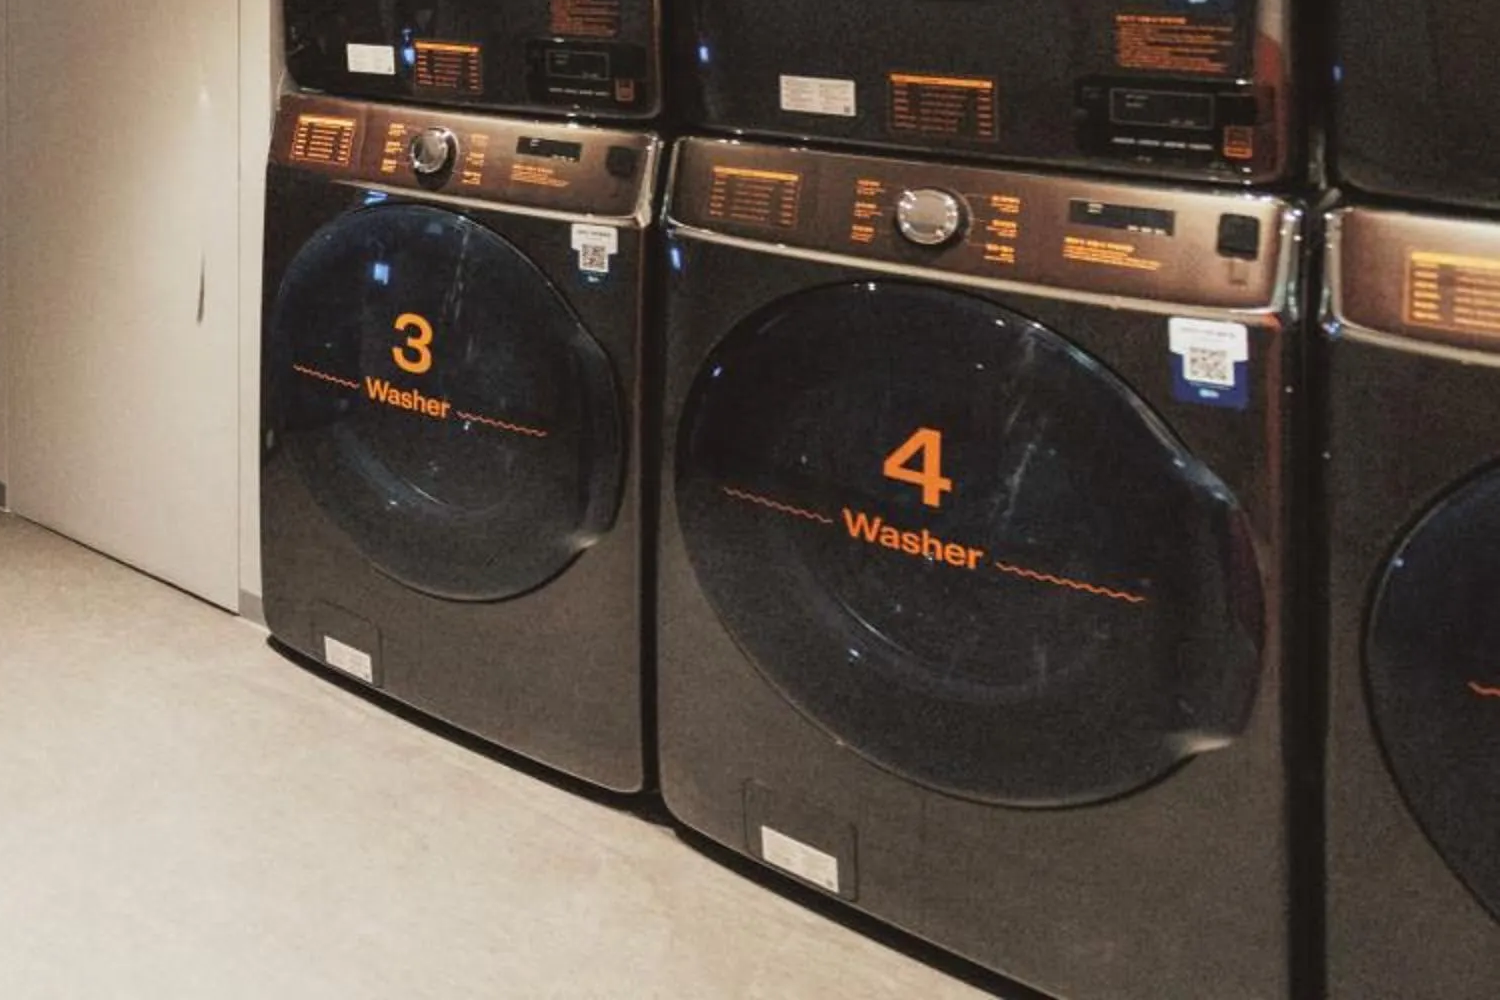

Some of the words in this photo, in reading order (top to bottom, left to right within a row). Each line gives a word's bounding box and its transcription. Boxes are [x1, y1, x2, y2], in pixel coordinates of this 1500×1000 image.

[390, 311, 434, 376] 3
[364, 376, 451, 418] Washer
[883, 427, 955, 508] 4
[843, 507, 984, 569] Washer
